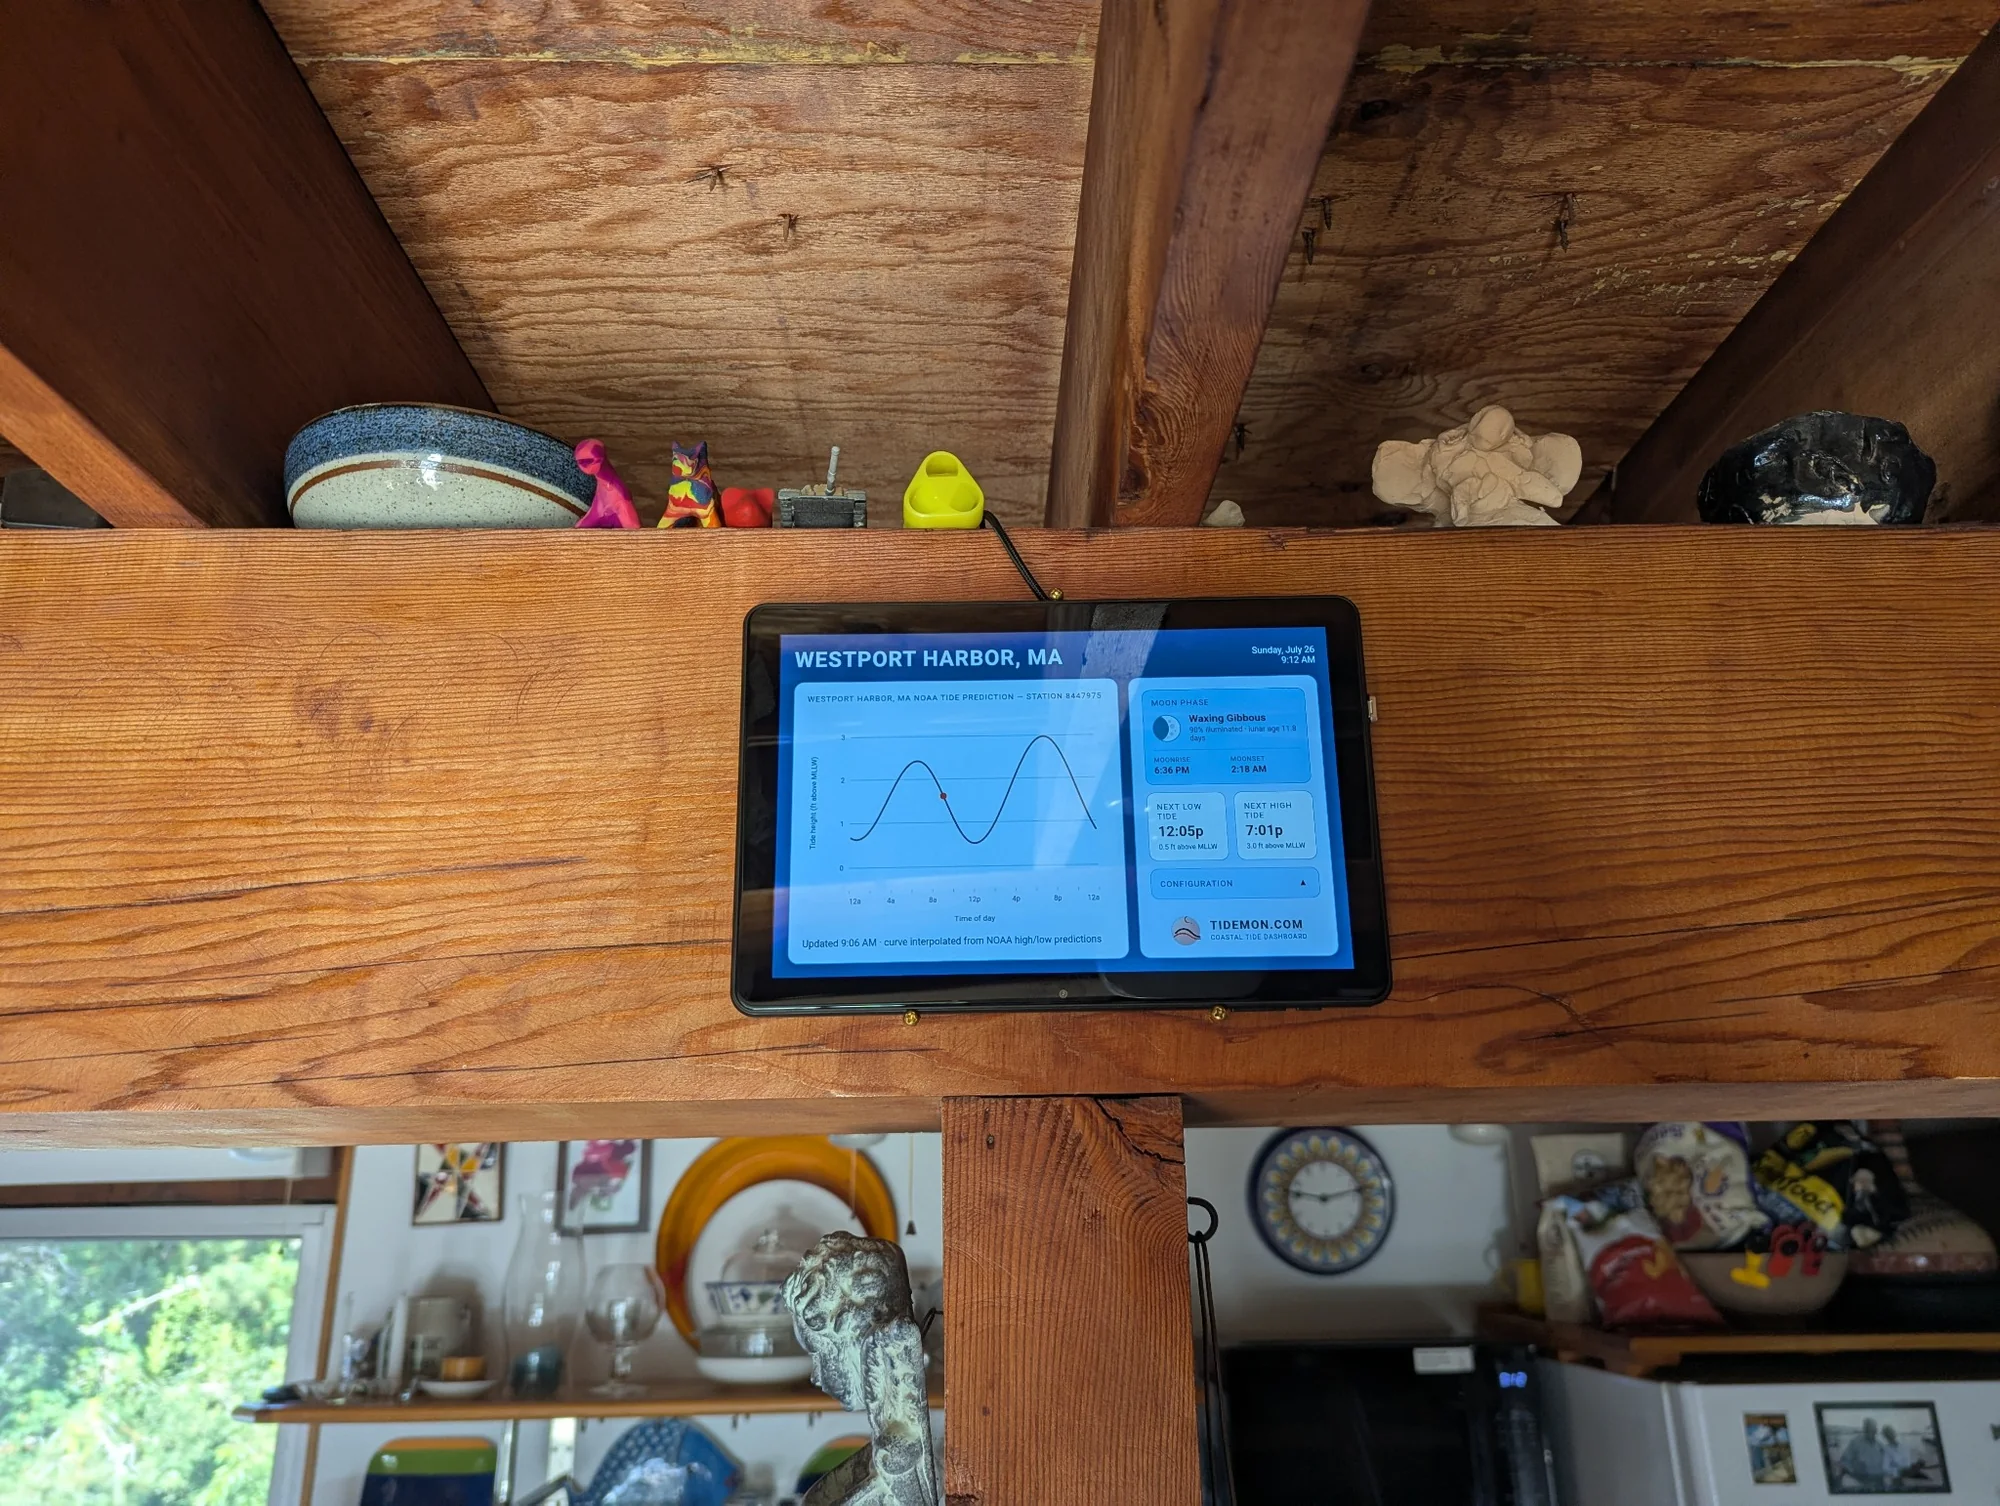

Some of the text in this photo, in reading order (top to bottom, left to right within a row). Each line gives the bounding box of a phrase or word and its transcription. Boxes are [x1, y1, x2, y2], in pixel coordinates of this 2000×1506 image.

[1252, 646, 1284, 655] Sunday,
[1285, 646, 1302, 654] July
[795, 649, 1062, 669] WESTPORT HARBOR, MA
[1189, 715, 1224, 724] Waxing
[1190, 735, 1205, 743] days
[1159, 825, 1204, 839] 12:05p
[1246, 825, 1283, 838] 7:01p
[1210, 919, 1302, 930] TIDEMON.COM
[802, 939, 838, 949] Updated
[862, 938, 876, 946] AM
[910, 937, 961, 947] interpolated
[964, 936, 984, 945] from
[986, 936, 1012, 944] NOAA
[1015, 935, 1051, 944] high/low
[1054, 934, 1101, 944] predictions
